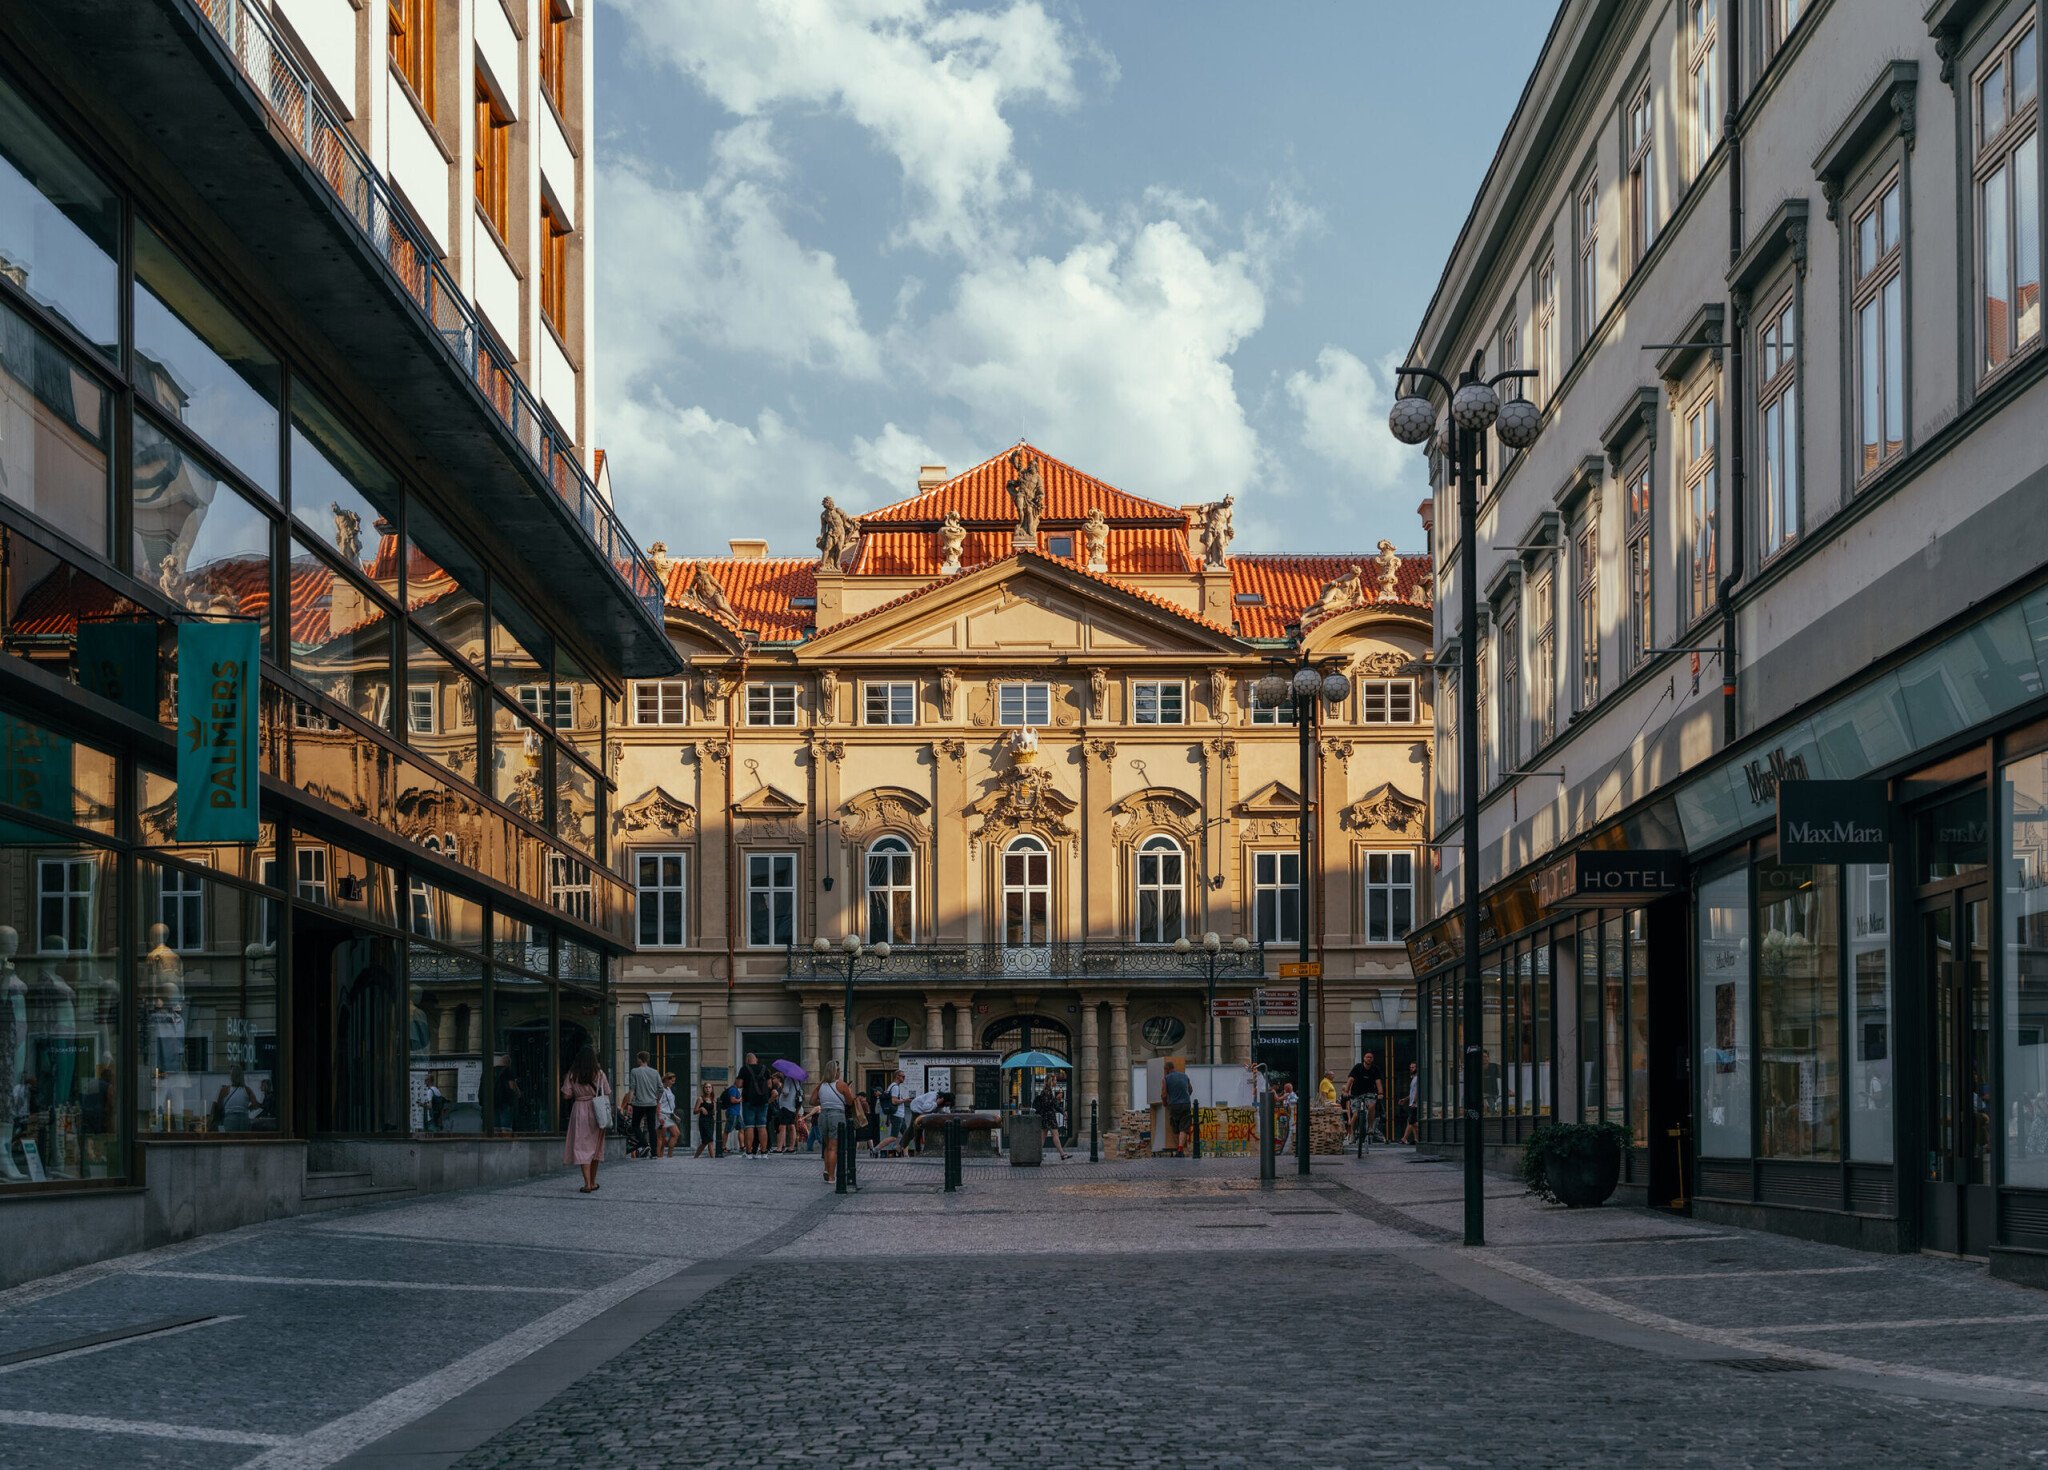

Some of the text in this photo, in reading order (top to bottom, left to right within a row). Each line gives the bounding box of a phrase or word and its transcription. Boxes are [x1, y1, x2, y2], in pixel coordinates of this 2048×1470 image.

[210, 660, 238, 808] PALMERS
[1787, 821, 1884, 844] MaxMara
[1584, 871, 1676, 888] HOTEL
[227, 1016, 249, 1037] BACK
[227, 1041, 258, 1063] SCHOOL
[1228, 1123, 1260, 1142] BRICK
